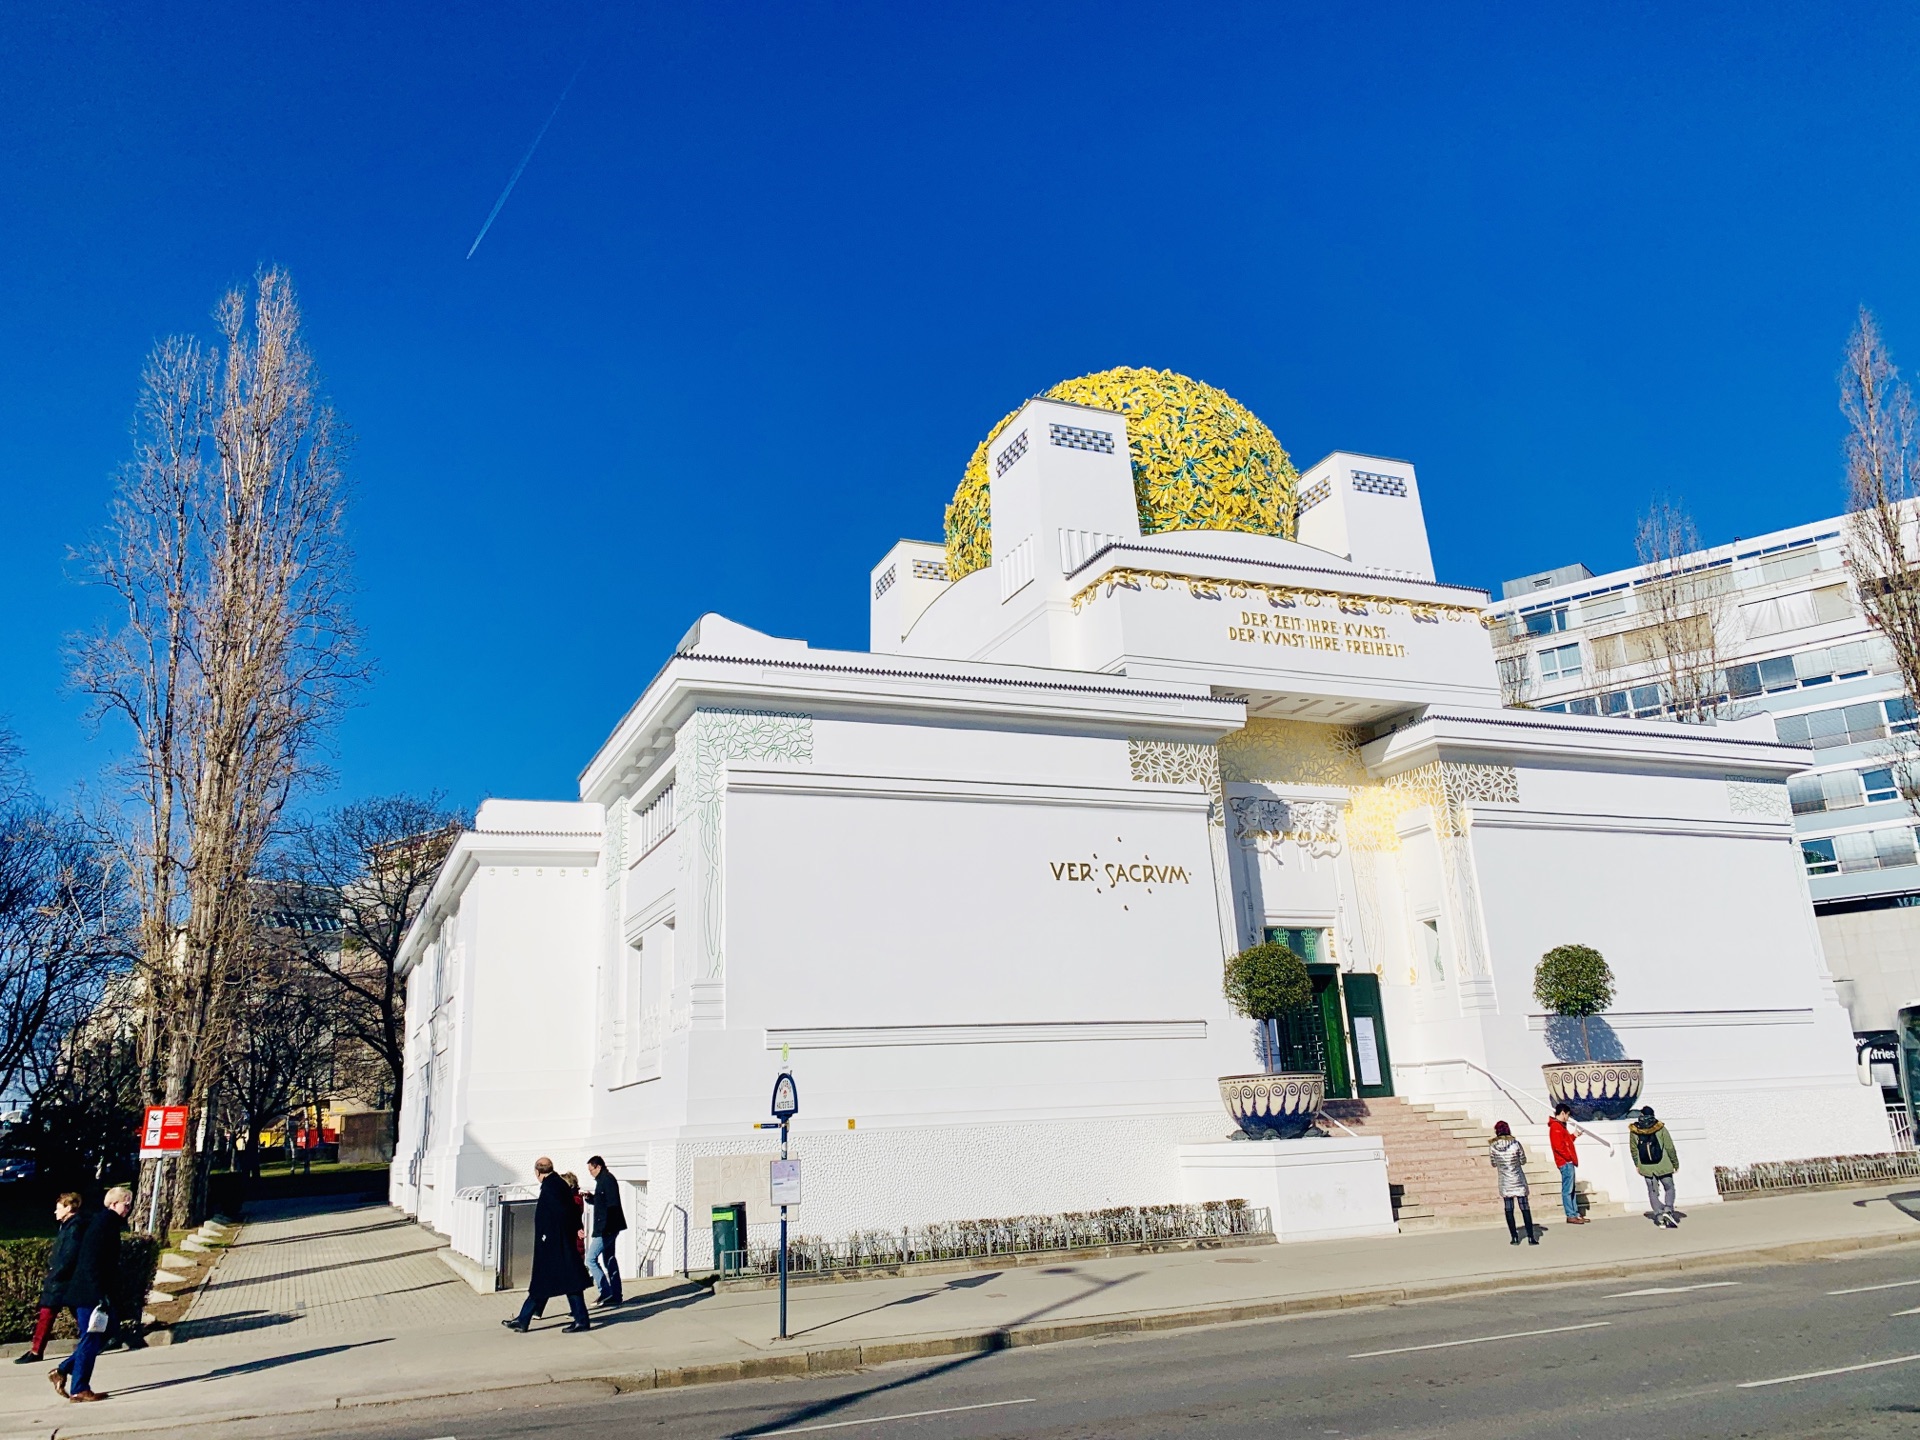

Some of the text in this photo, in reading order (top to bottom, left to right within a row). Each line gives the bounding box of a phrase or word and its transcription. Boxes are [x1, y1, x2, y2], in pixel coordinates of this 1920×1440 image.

[1241, 611, 1268, 626] DER
[1274, 614, 1301, 631] ZEIT
[1306, 618, 1339, 635] IHRE
[1229, 627, 1255, 643] DER
[1309, 635, 1341, 652] IHRE
[1049, 862, 1095, 882] VER
